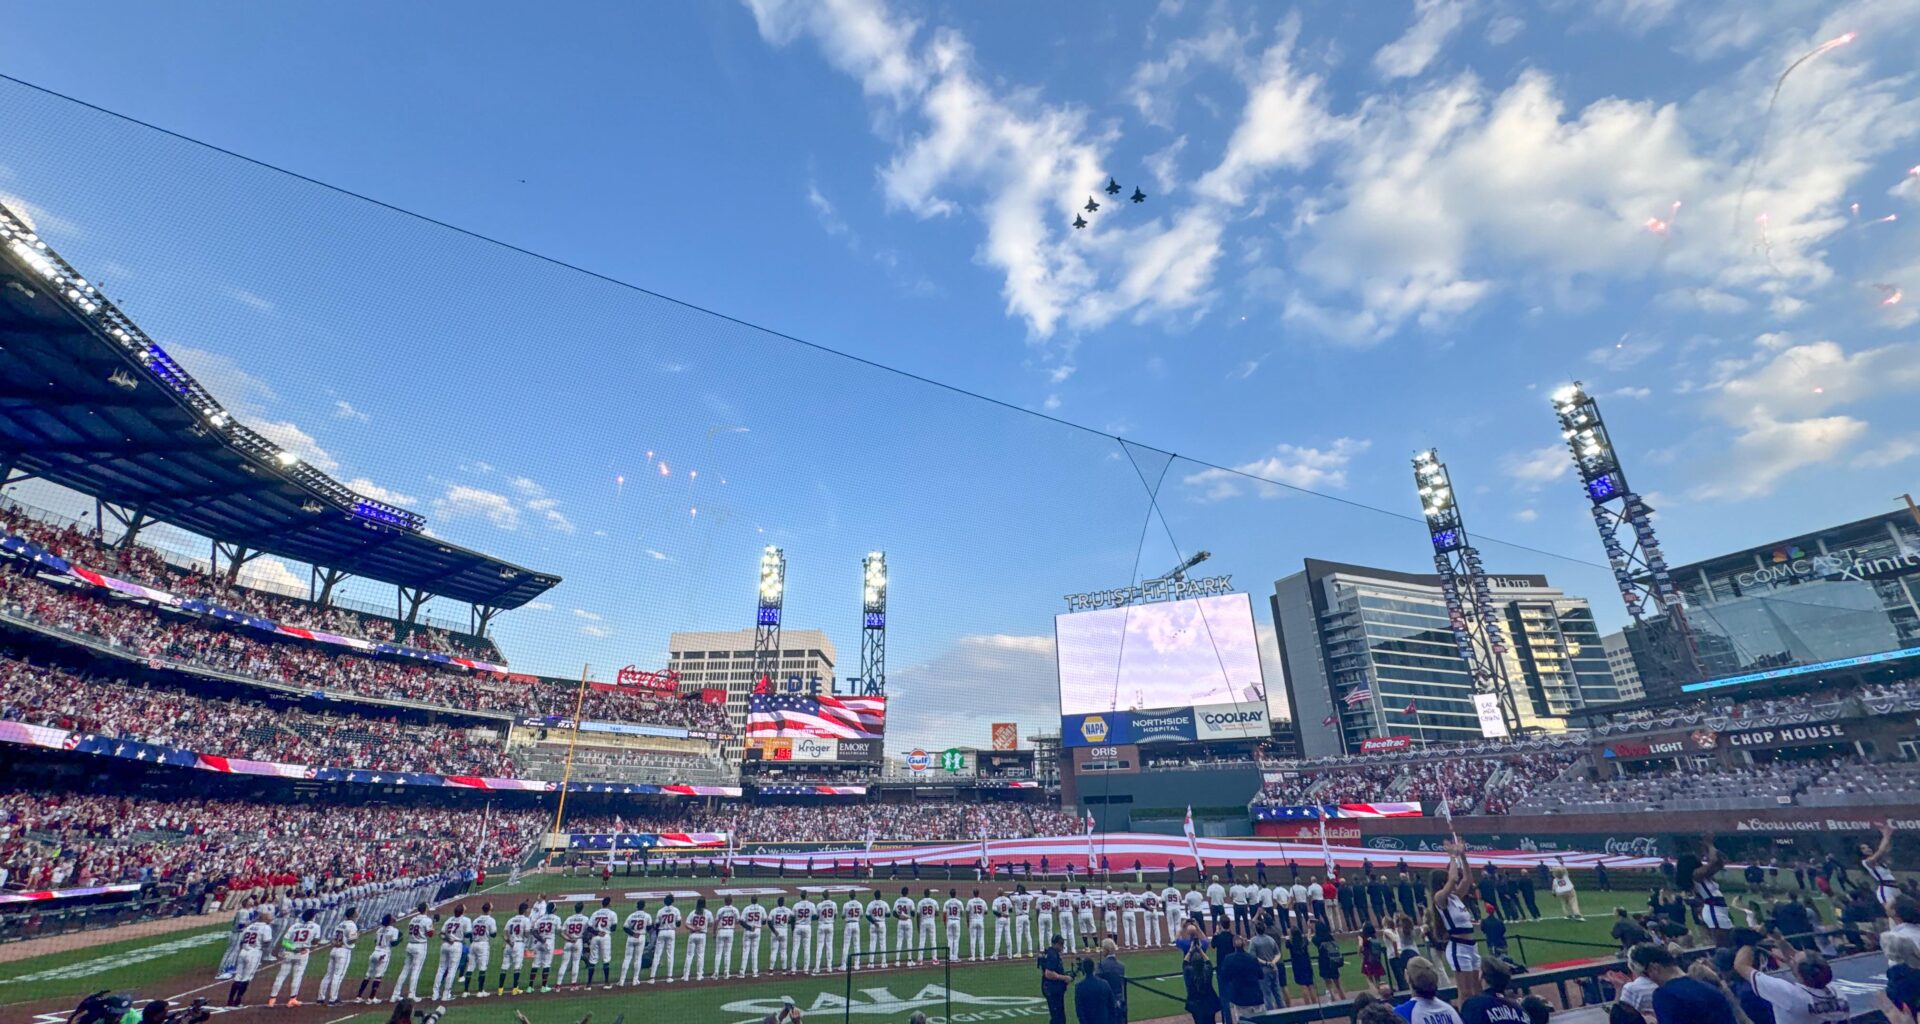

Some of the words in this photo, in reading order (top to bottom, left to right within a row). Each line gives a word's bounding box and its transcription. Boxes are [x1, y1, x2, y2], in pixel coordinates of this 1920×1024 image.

[1737, 547, 1856, 587] COMCAST
[1064, 586, 1138, 610] TRUIST
[1174, 574, 1235, 597] PARK
[787, 674, 880, 695] DELTA
[1132, 716, 1190, 727] NORTHSIDE
[1205, 710, 1264, 725] COOLRAY
[1085, 722, 1105, 735] NAPA
[1143, 725, 1180, 733] HOSPITAL
[1730, 731, 1774, 746] CHOP
[1780, 724, 1845, 741] HOUSE
[799, 739, 831, 757] Kroger
[839, 743, 869, 751] EMORY
[1364, 738, 1405, 750] RaceTrac
[1649, 741, 1683, 753] LIGHT
[1091, 747, 1117, 756] ORIS
[908, 756, 928, 764] Gulf
[1786, 821, 1820, 831] LIGHT
[1826, 819, 1870, 830] BELOW
[1374, 838, 1398, 849] Ford
[748, 912, 760, 922] 55
[848, 908, 860, 918] 45
[872, 907, 883, 917] 40
[595, 917, 608, 927] 75
[662, 914, 674, 924] 70
[447, 923, 460, 934] 27
[539, 922, 553, 933] 23
[243, 932, 257, 944] 22
[293, 930, 309, 942] 13
